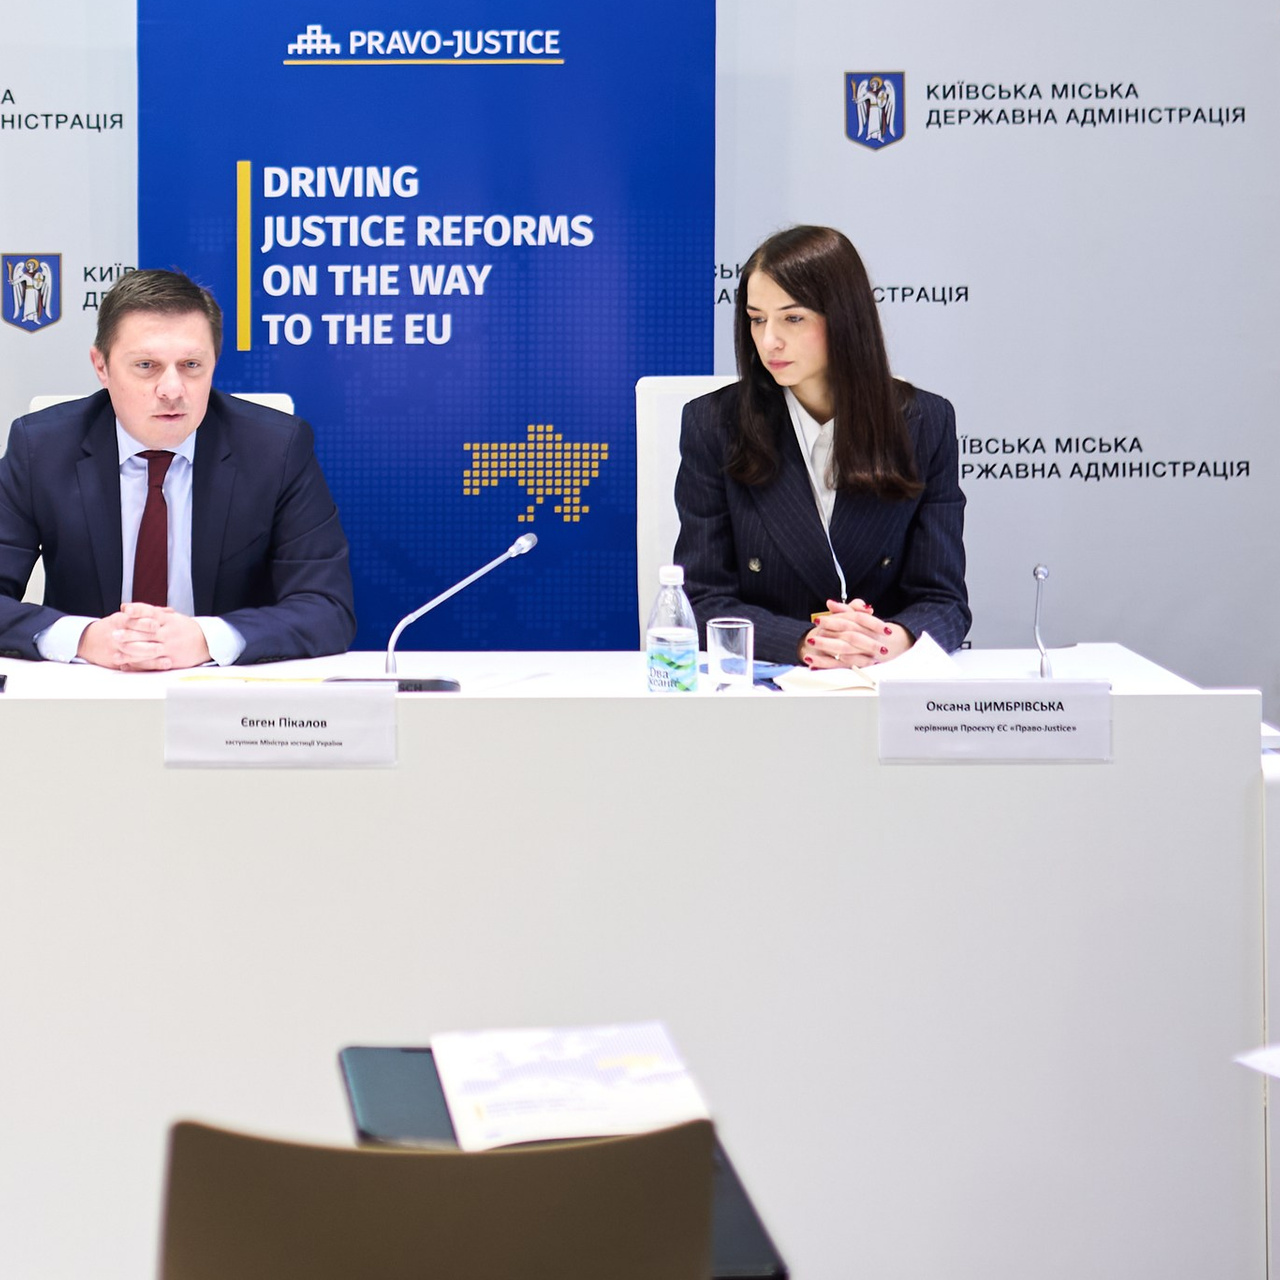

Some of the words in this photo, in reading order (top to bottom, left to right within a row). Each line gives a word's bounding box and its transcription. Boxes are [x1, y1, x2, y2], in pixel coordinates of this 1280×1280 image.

[349, 29, 561, 58] PRAVO-JUSTICE
[926, 81, 1043, 101] КИЇВСЬКА
[1051, 82, 1139, 100] МІСЬКА
[925, 108, 1058, 129] ДЕРЖАВНА
[1065, 106, 1246, 128] АДМІНІСТРАЦІЯ
[263, 166, 418, 198] DRIVING
[260, 214, 406, 254] JUSTICE
[417, 215, 593, 246] REFORMS
[263, 265, 317, 296] ON
[327, 264, 400, 296] THE
[409, 265, 492, 296] WAY
[261, 313, 313, 346] TO
[321, 313, 394, 347] THE
[403, 310, 452, 347] EU
[1055, 436, 1143, 454] МІСЬКА
[961, 462, 1062, 480] РЖАВНА
[1069, 460, 1250, 482] АДМІНІСТРАЦІЯ
[926, 701, 971, 712] Оксана
[974, 701, 1065, 713] ЦИМБРІВСЬКА
[241, 717, 275, 728] Євген
[279, 717, 327, 728] Пікалов
[914, 724, 958, 733] керівниця
[960, 724, 995, 733] Проєкту
[997, 724, 1008, 732] ЄС
